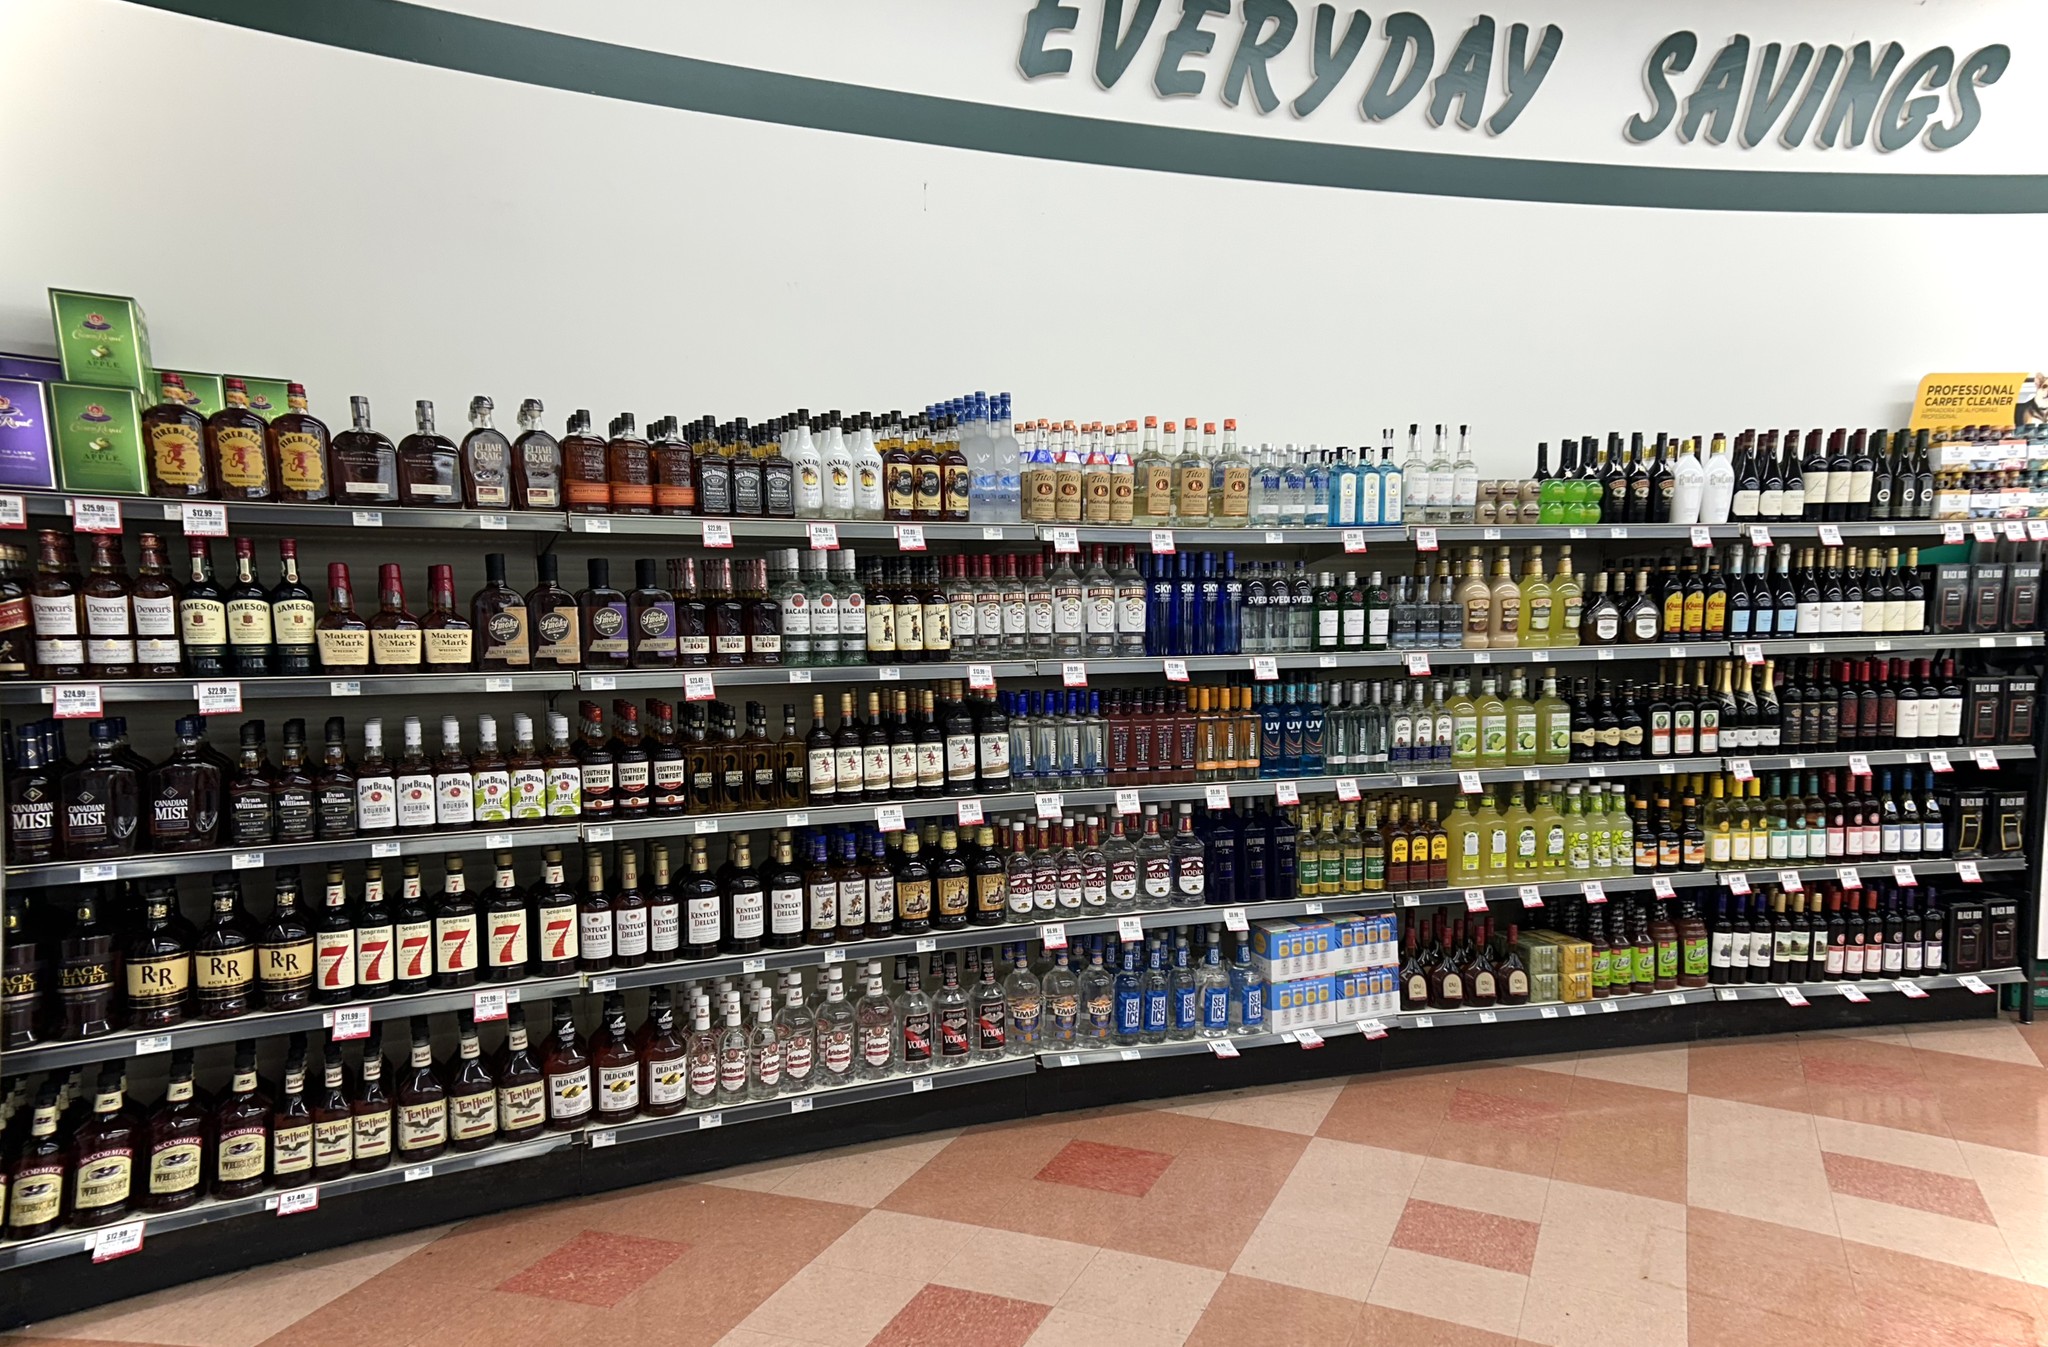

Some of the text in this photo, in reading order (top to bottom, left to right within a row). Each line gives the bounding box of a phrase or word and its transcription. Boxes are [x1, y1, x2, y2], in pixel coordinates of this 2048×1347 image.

[1019, 0, 2010, 152] EVERYDAY SAVINGS
[86, 360, 120, 368] APPLE
[1927, 385, 2014, 395] PROFESSIONAL
[1925, 396, 2013, 406] CARPET CLEANER
[152, 425, 197, 442] FIREBALL
[218, 430, 261, 444] FIREBALL
[280, 436, 320, 450] FIREBALL
[475, 442, 501, 452] ELIJAH
[525, 444, 551, 454] ELIJAH
[82, 453, 119, 461] APPLE
[475, 451, 502, 461] CRAIG
[525, 453, 551, 462] CRAIG
[82, 504, 105, 512] $25.99
[192, 509, 212, 517] $12.99
[1943, 570, 1967, 579] BLACK BOX
[35, 603, 73, 613] Dewar's
[89, 603, 126, 613] Dewar's
[137, 604, 171, 614] Dewar's
[181, 603, 220, 613] JAMESON
[228, 603, 268, 613] JAMESON
[277, 604, 313, 613] JAMESON
[208, 687, 227, 695] $22.99
[2010, 682, 2035, 691] BLACK BOX
[63, 690, 86, 698] $24.99
[1287, 722, 1302, 730] UV
[1306, 720, 1322, 729] UV
[583, 769, 611, 778] SOUTHERN
[656, 765, 682, 774] SOUTHERN
[550, 772, 578, 785] JIM BEAM
[585, 776, 609, 784] COMFORT
[658, 772, 682, 780] COMFORT
[400, 780, 432, 792] JIM BEAM
[477, 777, 507, 789] JIM BEAM
[360, 782, 393, 795] JIM BEAM
[12, 802, 53, 813] CANADIAN
[155, 799, 188, 808] CANADIAN
[1961, 798, 1984, 807] BLACK BOX
[69, 804, 105, 812] CANADIAN
[363, 806, 390, 814] BOURBON
[156, 807, 188, 821] MIST
[13, 814, 53, 829] MIST
[69, 813, 104, 827] MIST
[774, 903, 801, 911] KENTUCKY
[1991, 906, 2015, 915] BLACK BOX
[691, 910, 719, 919] KENTUCKY
[618, 922, 646, 931] KENTUCKY
[695, 918, 716, 926] DELUXE
[622, 930, 644, 938] DELUXE
[494, 923, 521, 963] 7
[442, 929, 470, 969] 7
[360, 940, 389, 981] 7
[401, 936, 429, 976] 7
[319, 945, 348, 986] 7
[60, 972, 108, 986] ELVET
[481, 995, 496, 1003] $21.99
[1213, 998, 1224, 1007] SEA
[1127, 1002, 1138, 1012] SEA
[1154, 1001, 1164, 1011] SEA
[341, 1013, 358, 1021] $11.99
[1015, 1009, 1039, 1017] TAAKA
[1127, 1012, 1138, 1024] ICE
[1153, 1011, 1164, 1022] ICE
[1213, 1007, 1224, 1019] ICE
[982, 1028, 1005, 1037] VODKA
[907, 1038, 931, 1049] VODKA
[944, 1034, 967, 1043] VODKA
[569, 1075, 586, 1085] CROW
[618, 1071, 634, 1079] CROW
[507, 1085, 542, 1102] TEN HIGH
[405, 1105, 443, 1122] TEN HIGH
[221, 1127, 265, 1140] McCORMICK
[317, 1124, 347, 1137] TEN HIGH
[154, 1137, 202, 1152] McCORMICK
[80, 1149, 131, 1164] McCORMICK
[106, 1230, 127, 1240] $12.99
